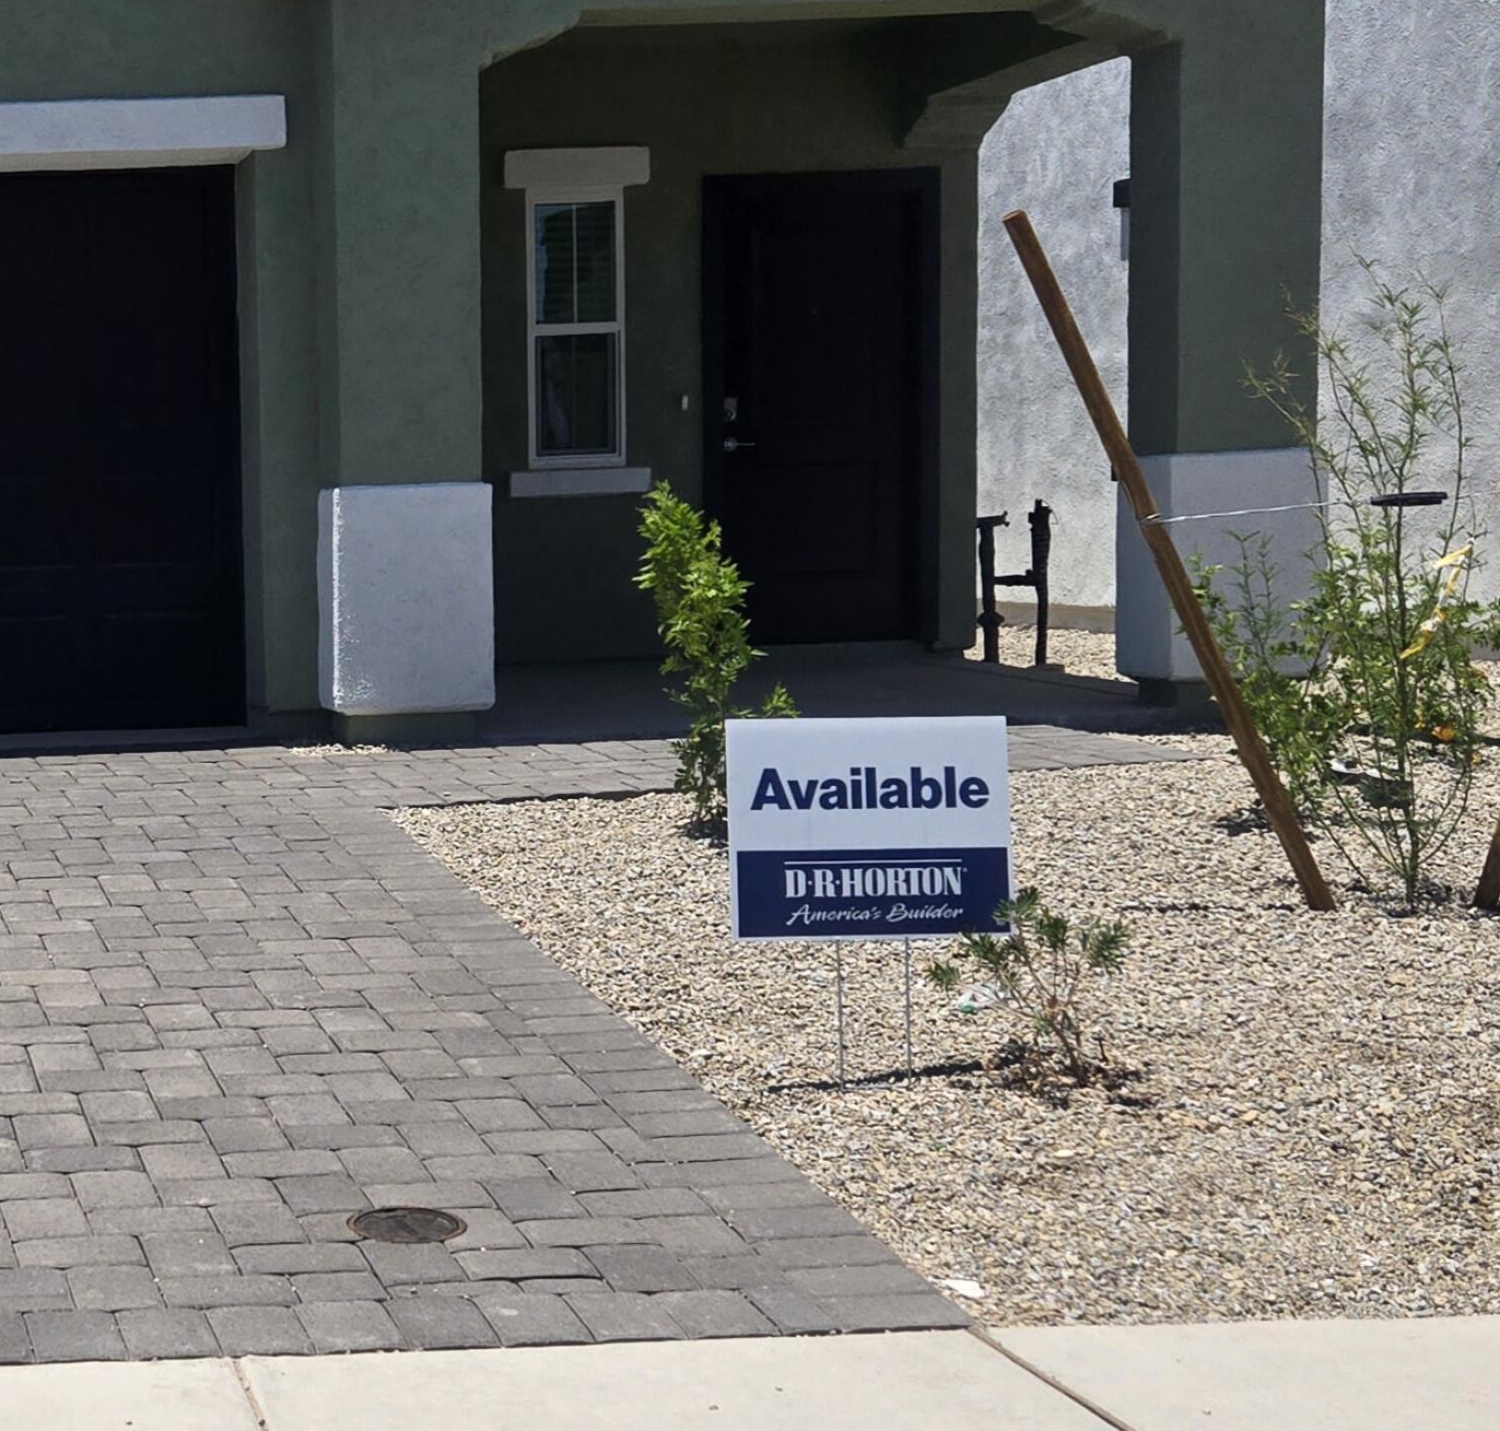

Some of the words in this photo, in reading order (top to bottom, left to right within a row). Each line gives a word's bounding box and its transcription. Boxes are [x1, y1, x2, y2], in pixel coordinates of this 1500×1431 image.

[750, 766, 990, 811] Available
[785, 905, 881, 926] America's
[886, 902, 964, 923] Builder
